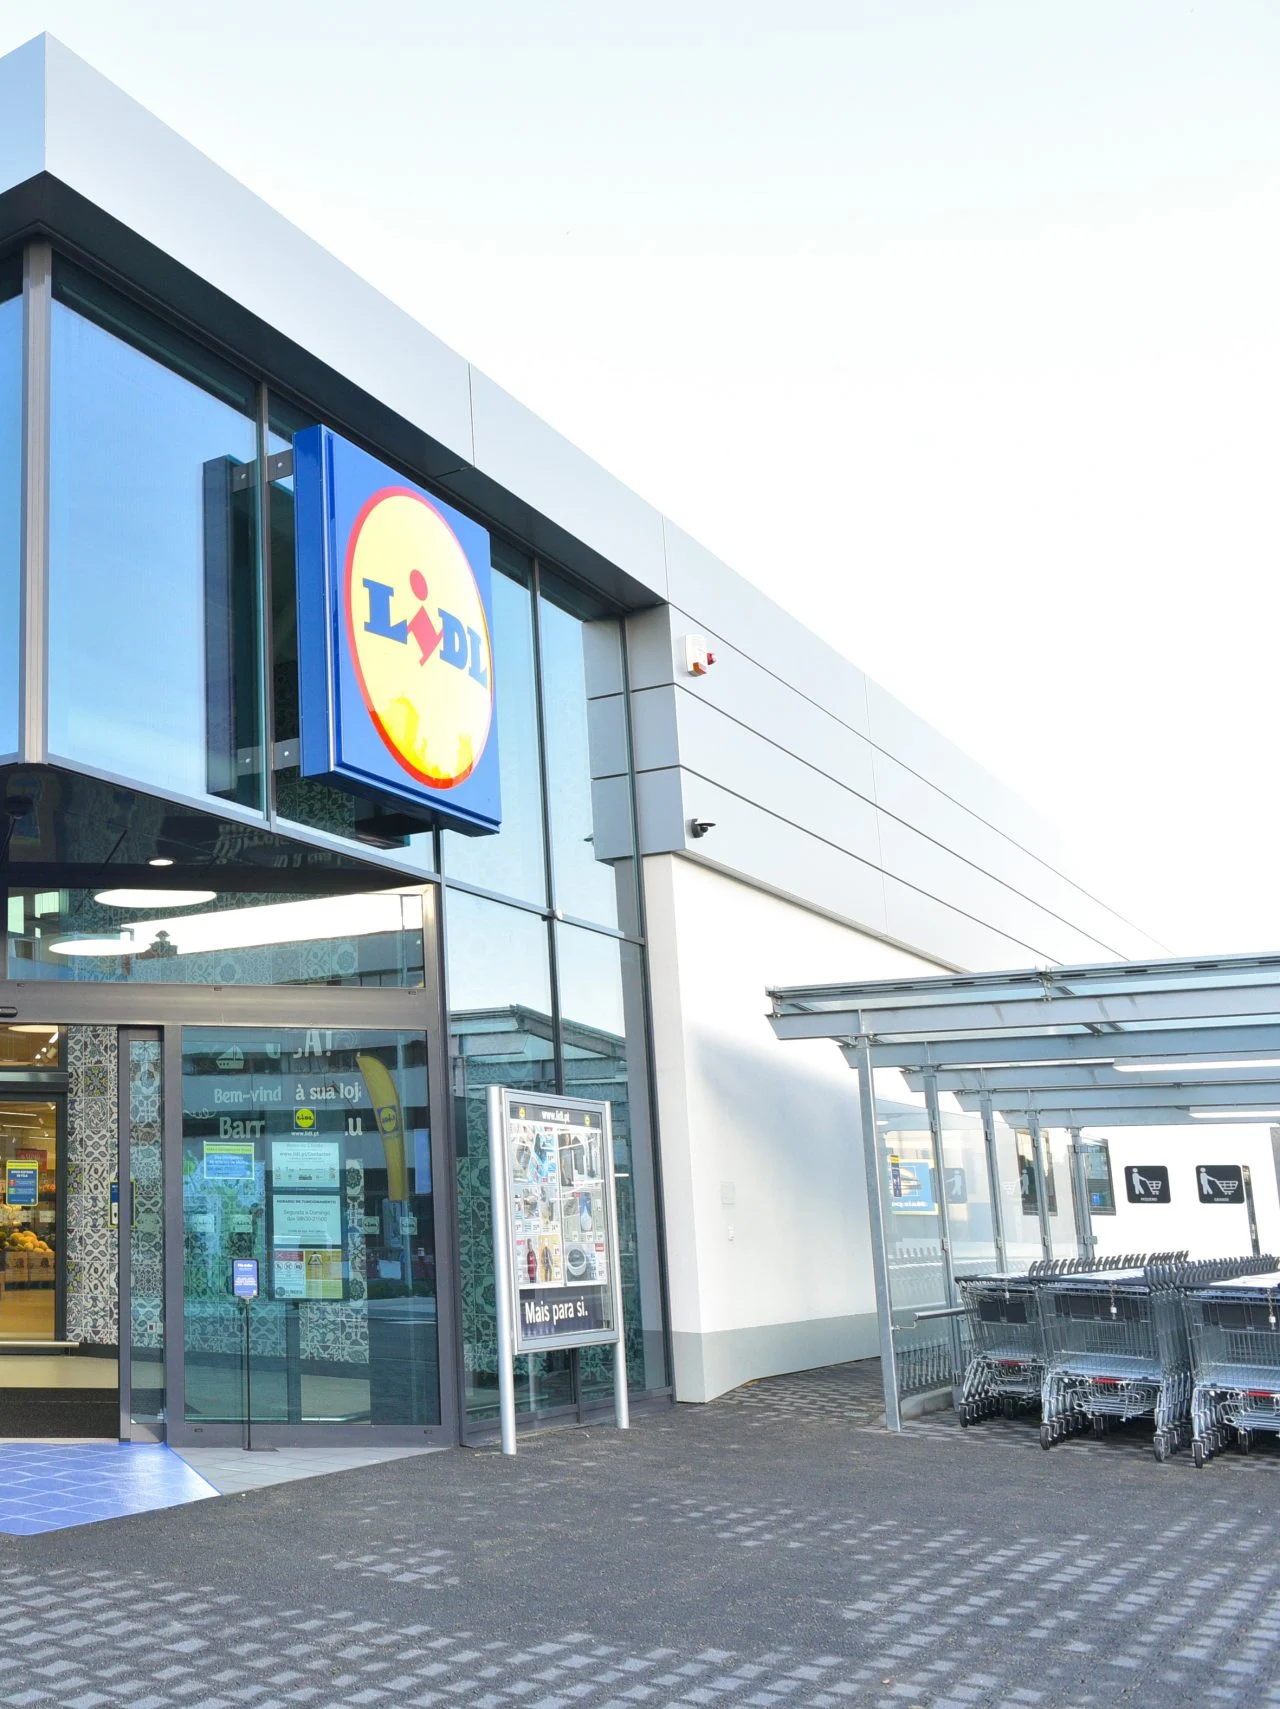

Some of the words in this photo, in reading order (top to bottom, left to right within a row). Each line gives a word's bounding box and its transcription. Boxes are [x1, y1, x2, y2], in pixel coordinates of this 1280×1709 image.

[214, 1085, 282, 1104] Bem-vind
[295, 1083, 305, 1101] à
[310, 1084, 336, 1101] sua
[340, 1081, 362, 1103] loj
[525, 1300, 550, 1324] Mais
[552, 1302, 575, 1325] para
[576, 1296, 588, 1317] si.
